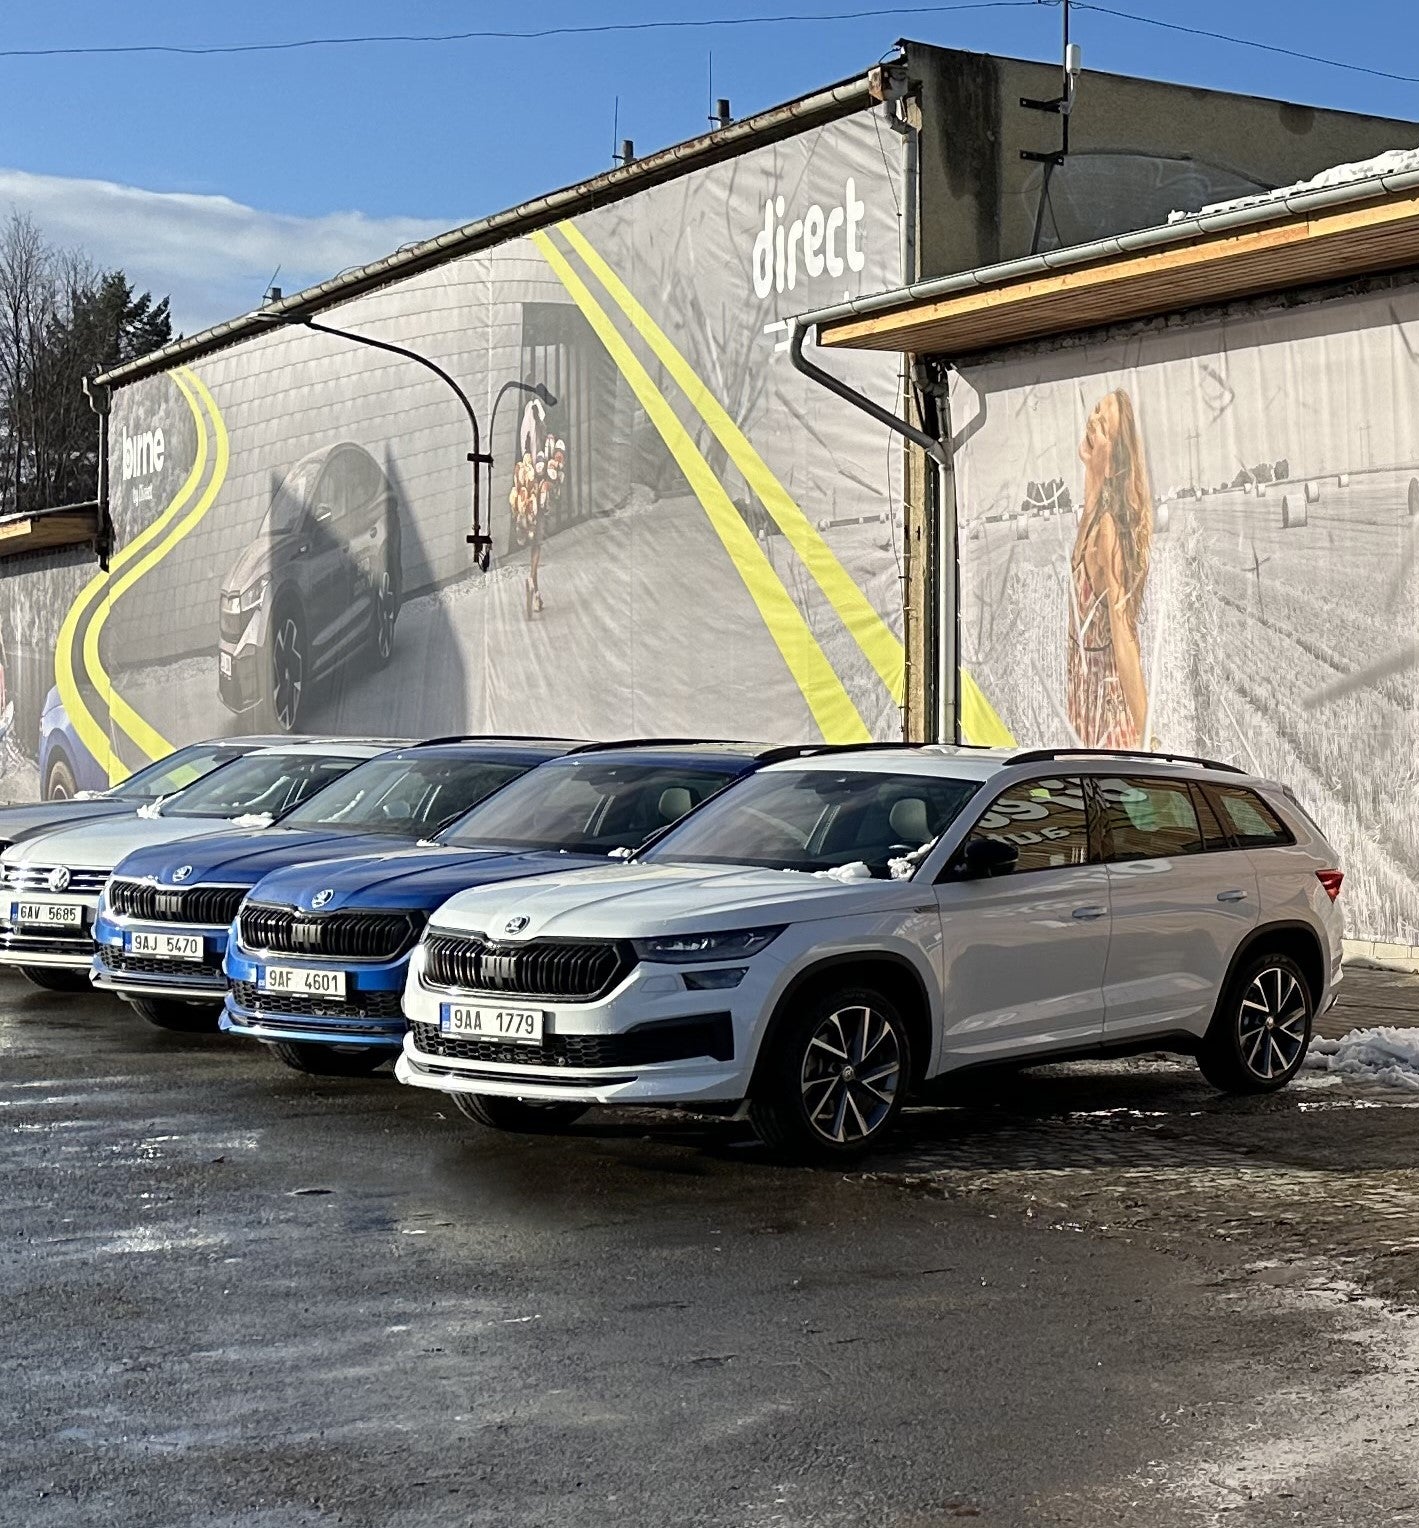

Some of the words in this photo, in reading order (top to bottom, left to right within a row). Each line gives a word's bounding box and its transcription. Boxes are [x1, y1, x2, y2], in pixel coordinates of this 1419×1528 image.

[752, 177, 865, 299] direct
[20, 905, 41, 920] 6AV
[48, 906, 77, 921] 5685
[134, 934, 158, 951] 9AJ
[166, 936, 198, 954] 5470
[269, 969, 294, 988] 9AF
[304, 972, 338, 992] 4601
[454, 1009, 482, 1030] 9AA
[495, 1011, 534, 1034] 1779
